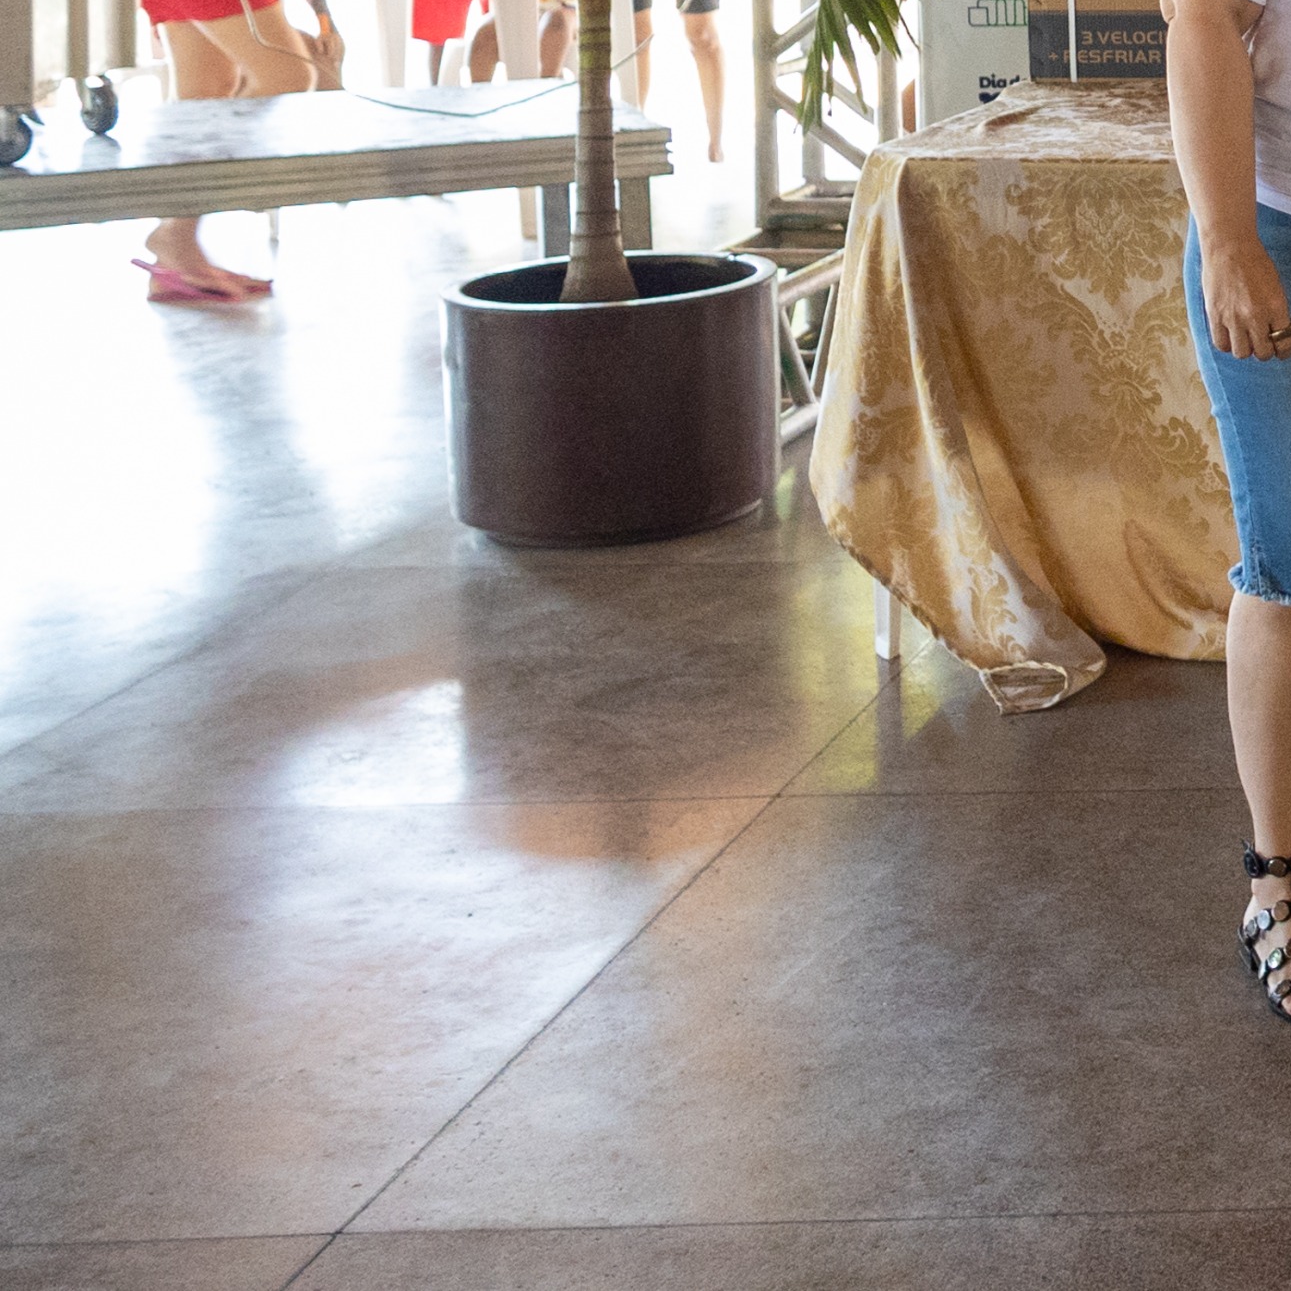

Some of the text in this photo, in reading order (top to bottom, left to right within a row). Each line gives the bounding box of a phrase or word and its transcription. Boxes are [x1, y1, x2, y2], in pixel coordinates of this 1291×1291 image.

[1082, 31, 1167, 45] 3 VELOCI
[979, 73, 1006, 88] Dia
